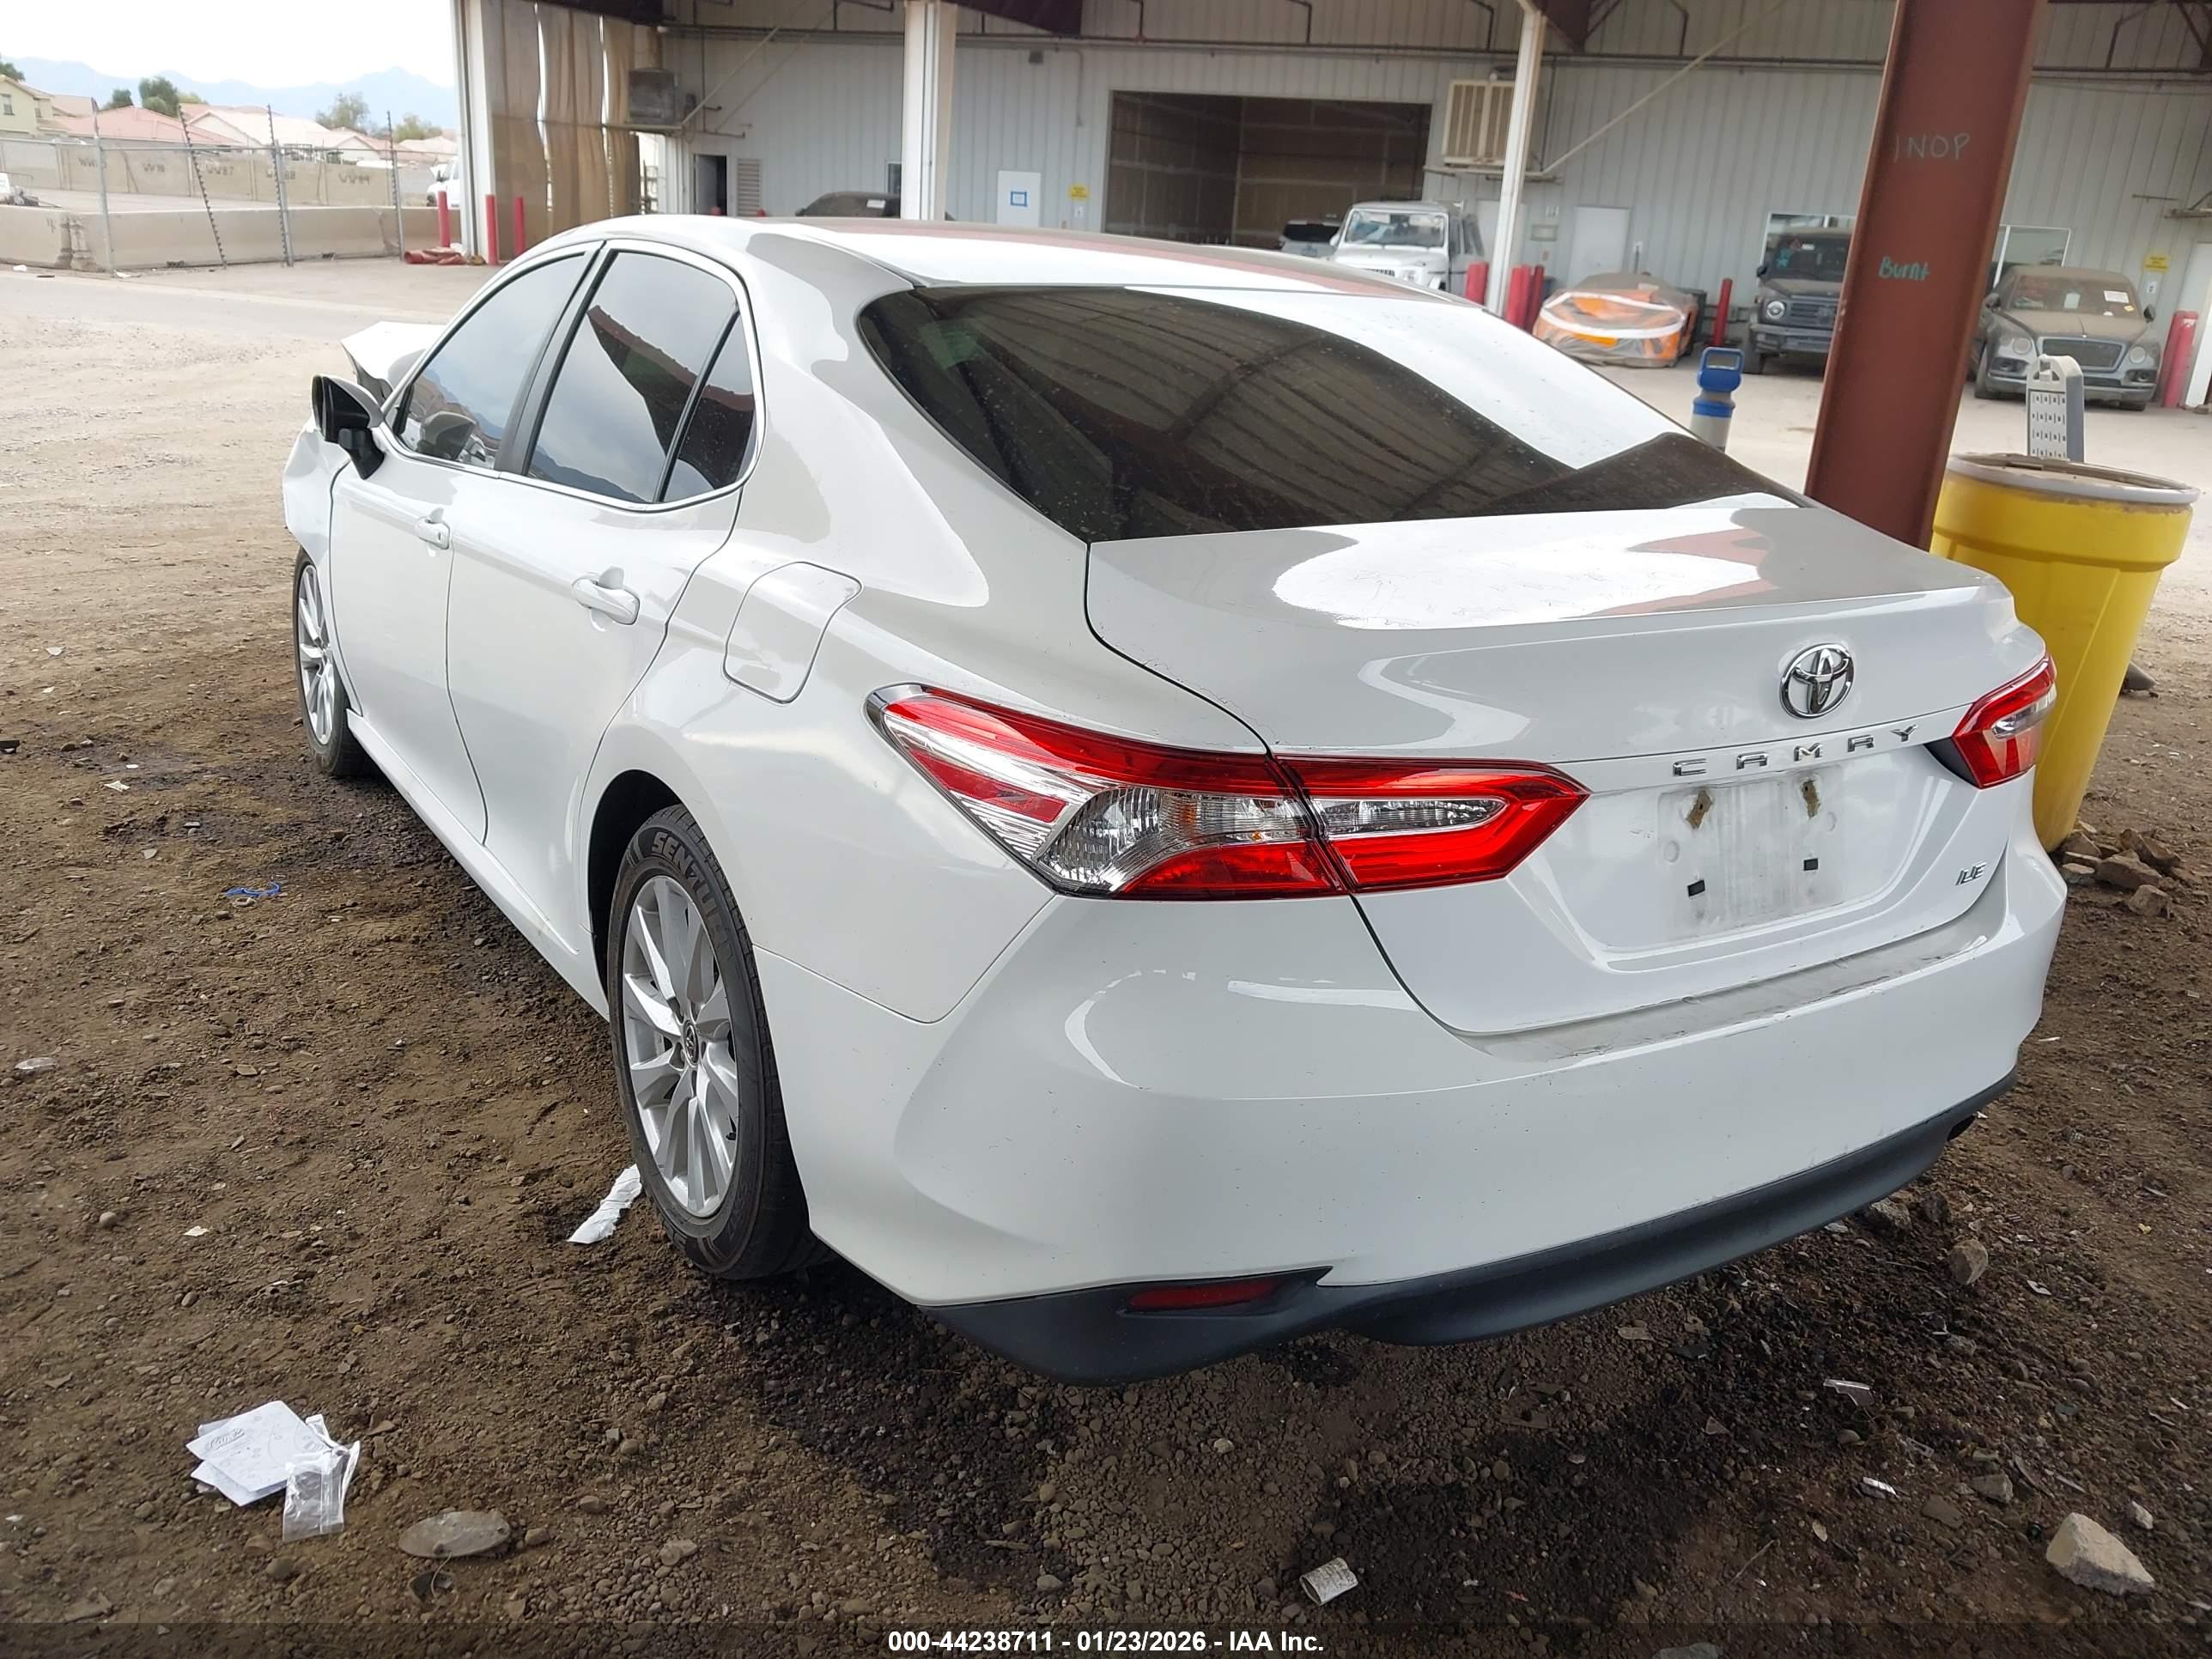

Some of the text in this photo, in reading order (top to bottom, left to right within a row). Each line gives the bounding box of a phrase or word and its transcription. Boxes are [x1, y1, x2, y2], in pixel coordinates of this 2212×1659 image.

[1894, 132, 1971, 163] INOP
[1879, 256, 1930, 281] Burnt
[1673, 724, 1918, 776] CAMRY
[1955, 861, 1987, 886] LE
